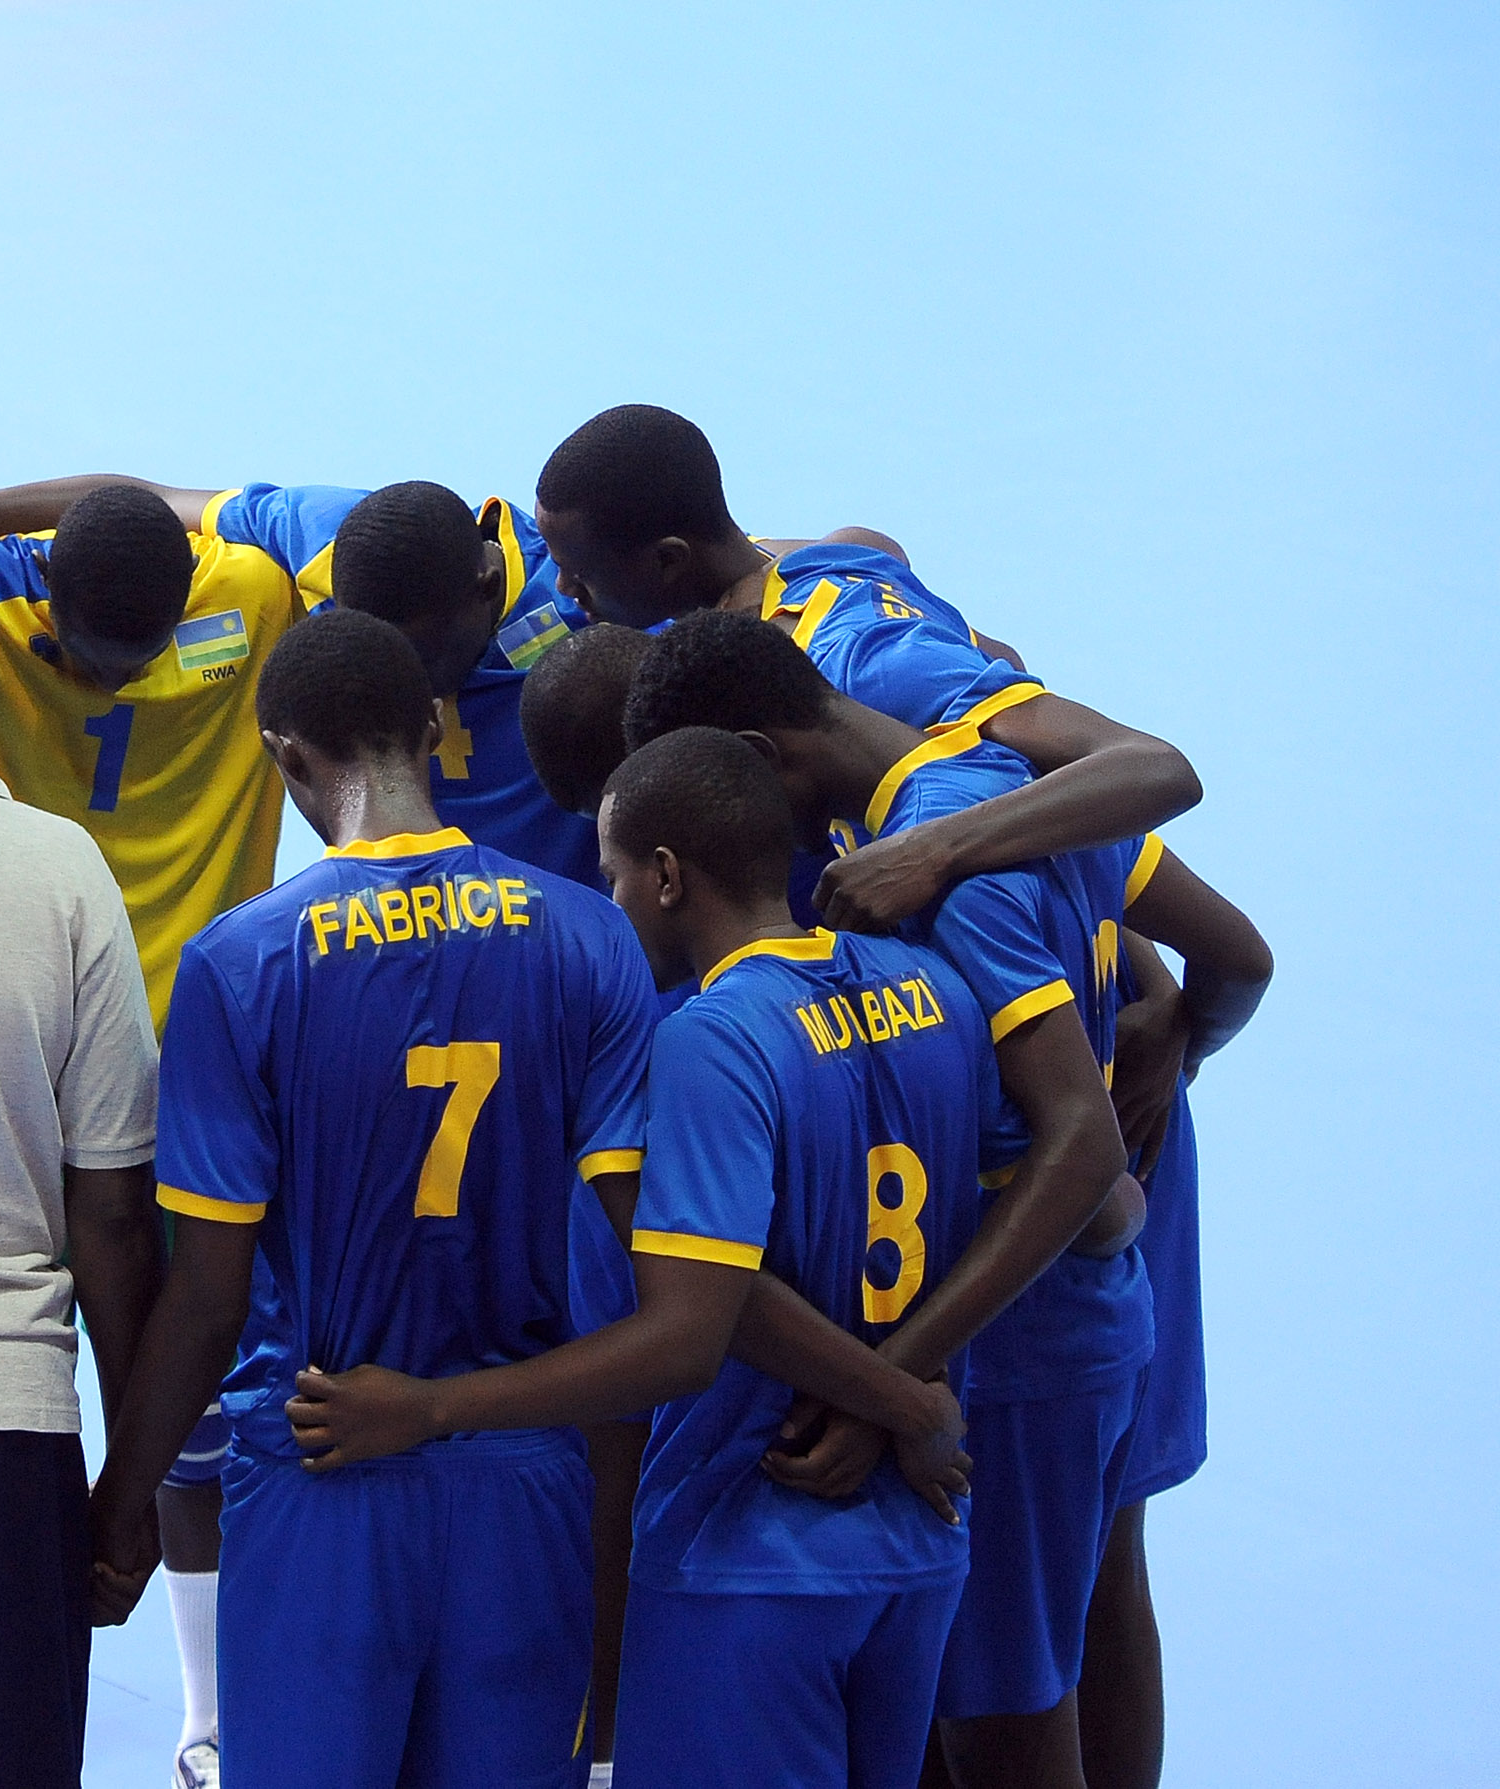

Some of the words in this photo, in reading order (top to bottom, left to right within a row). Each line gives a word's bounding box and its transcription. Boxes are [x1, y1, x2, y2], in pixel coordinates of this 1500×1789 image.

[202, 664, 237, 682] RWA
[84, 703, 135, 813] 1
[309, 879, 530, 956] FABRICE
[406, 1041, 501, 1218] 7
[862, 1142, 928, 1324] 8
